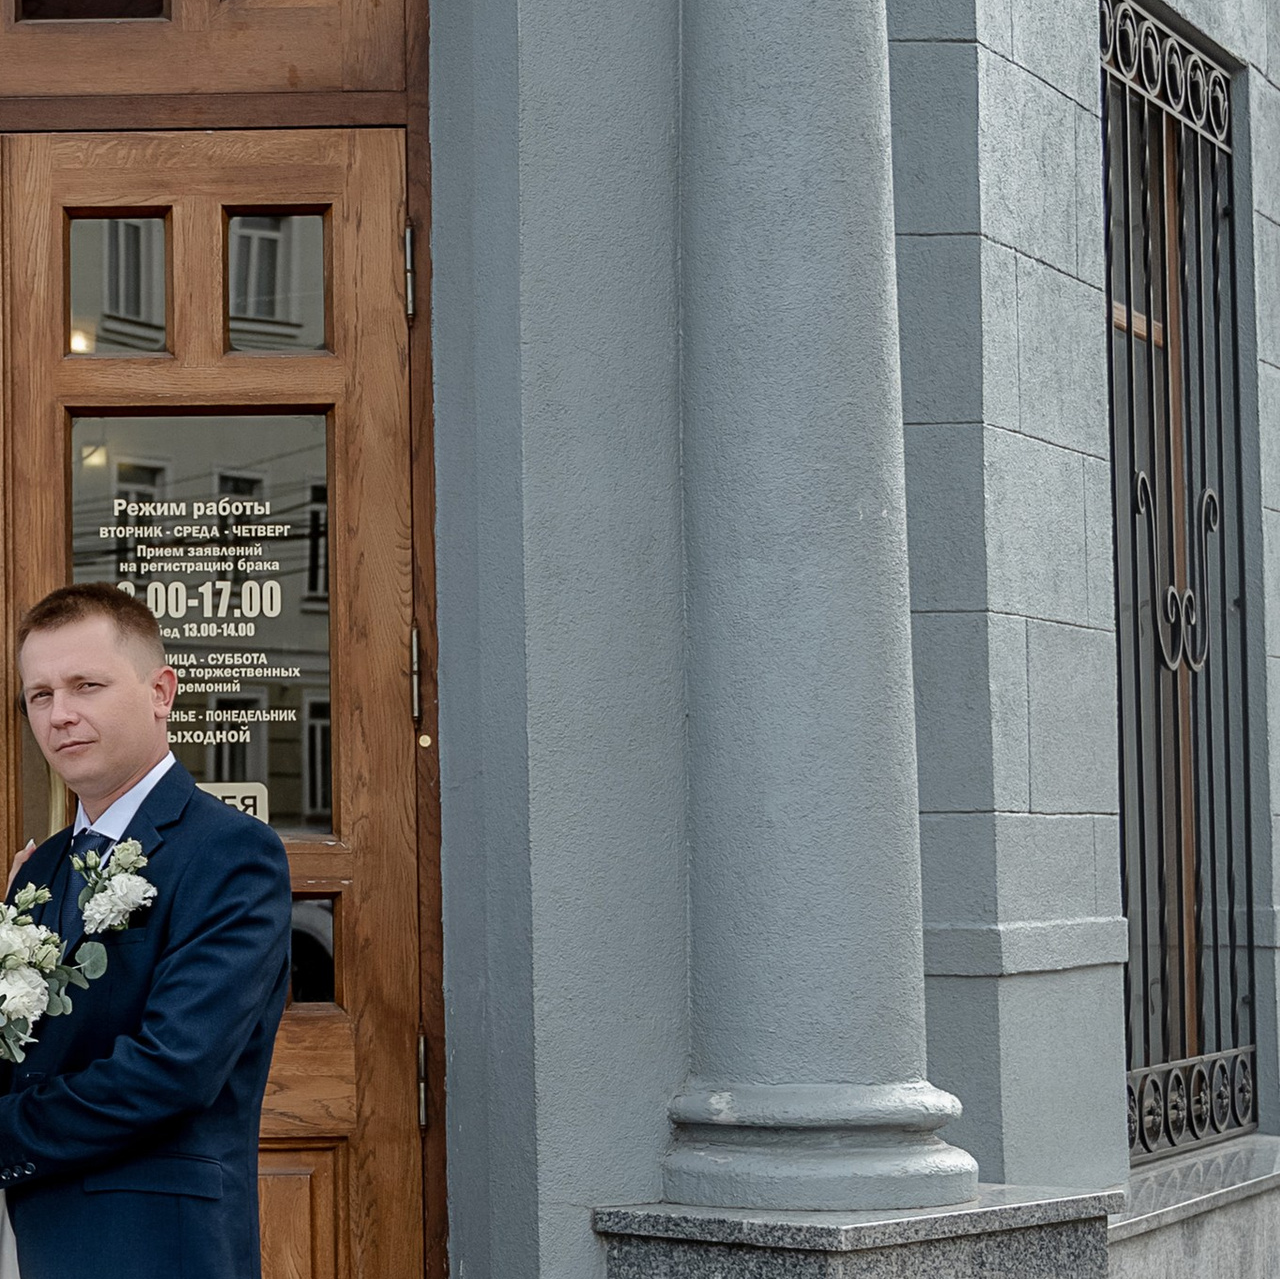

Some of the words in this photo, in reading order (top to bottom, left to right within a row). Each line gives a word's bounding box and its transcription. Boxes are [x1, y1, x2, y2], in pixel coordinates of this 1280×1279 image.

[113, 499, 187, 517] Режим
[193, 498, 271, 519] работы
[99, 526, 162, 538] ВТОРНИК
[174, 526, 220, 539] СРЕДА
[232, 525, 291, 537] ЧЕТВЕРГ
[137, 545, 184, 557] Прием
[187, 543, 263, 557] заявлений
[119, 562, 137, 572] на
[141, 560, 234, 575] регистрацию
[238, 559, 280, 573] брака
[116, 580, 282, 619] 00-17.00
[183, 623, 256, 637] 13.00-14.00
[208, 653, 267, 665] СУББОТА
[190, 666, 301, 680] торжественных
[177, 680, 241, 695] ремоний
[205, 709, 297, 723] ПОНЕДЕЛЬНИК
[167, 726, 251, 746] ыходной
